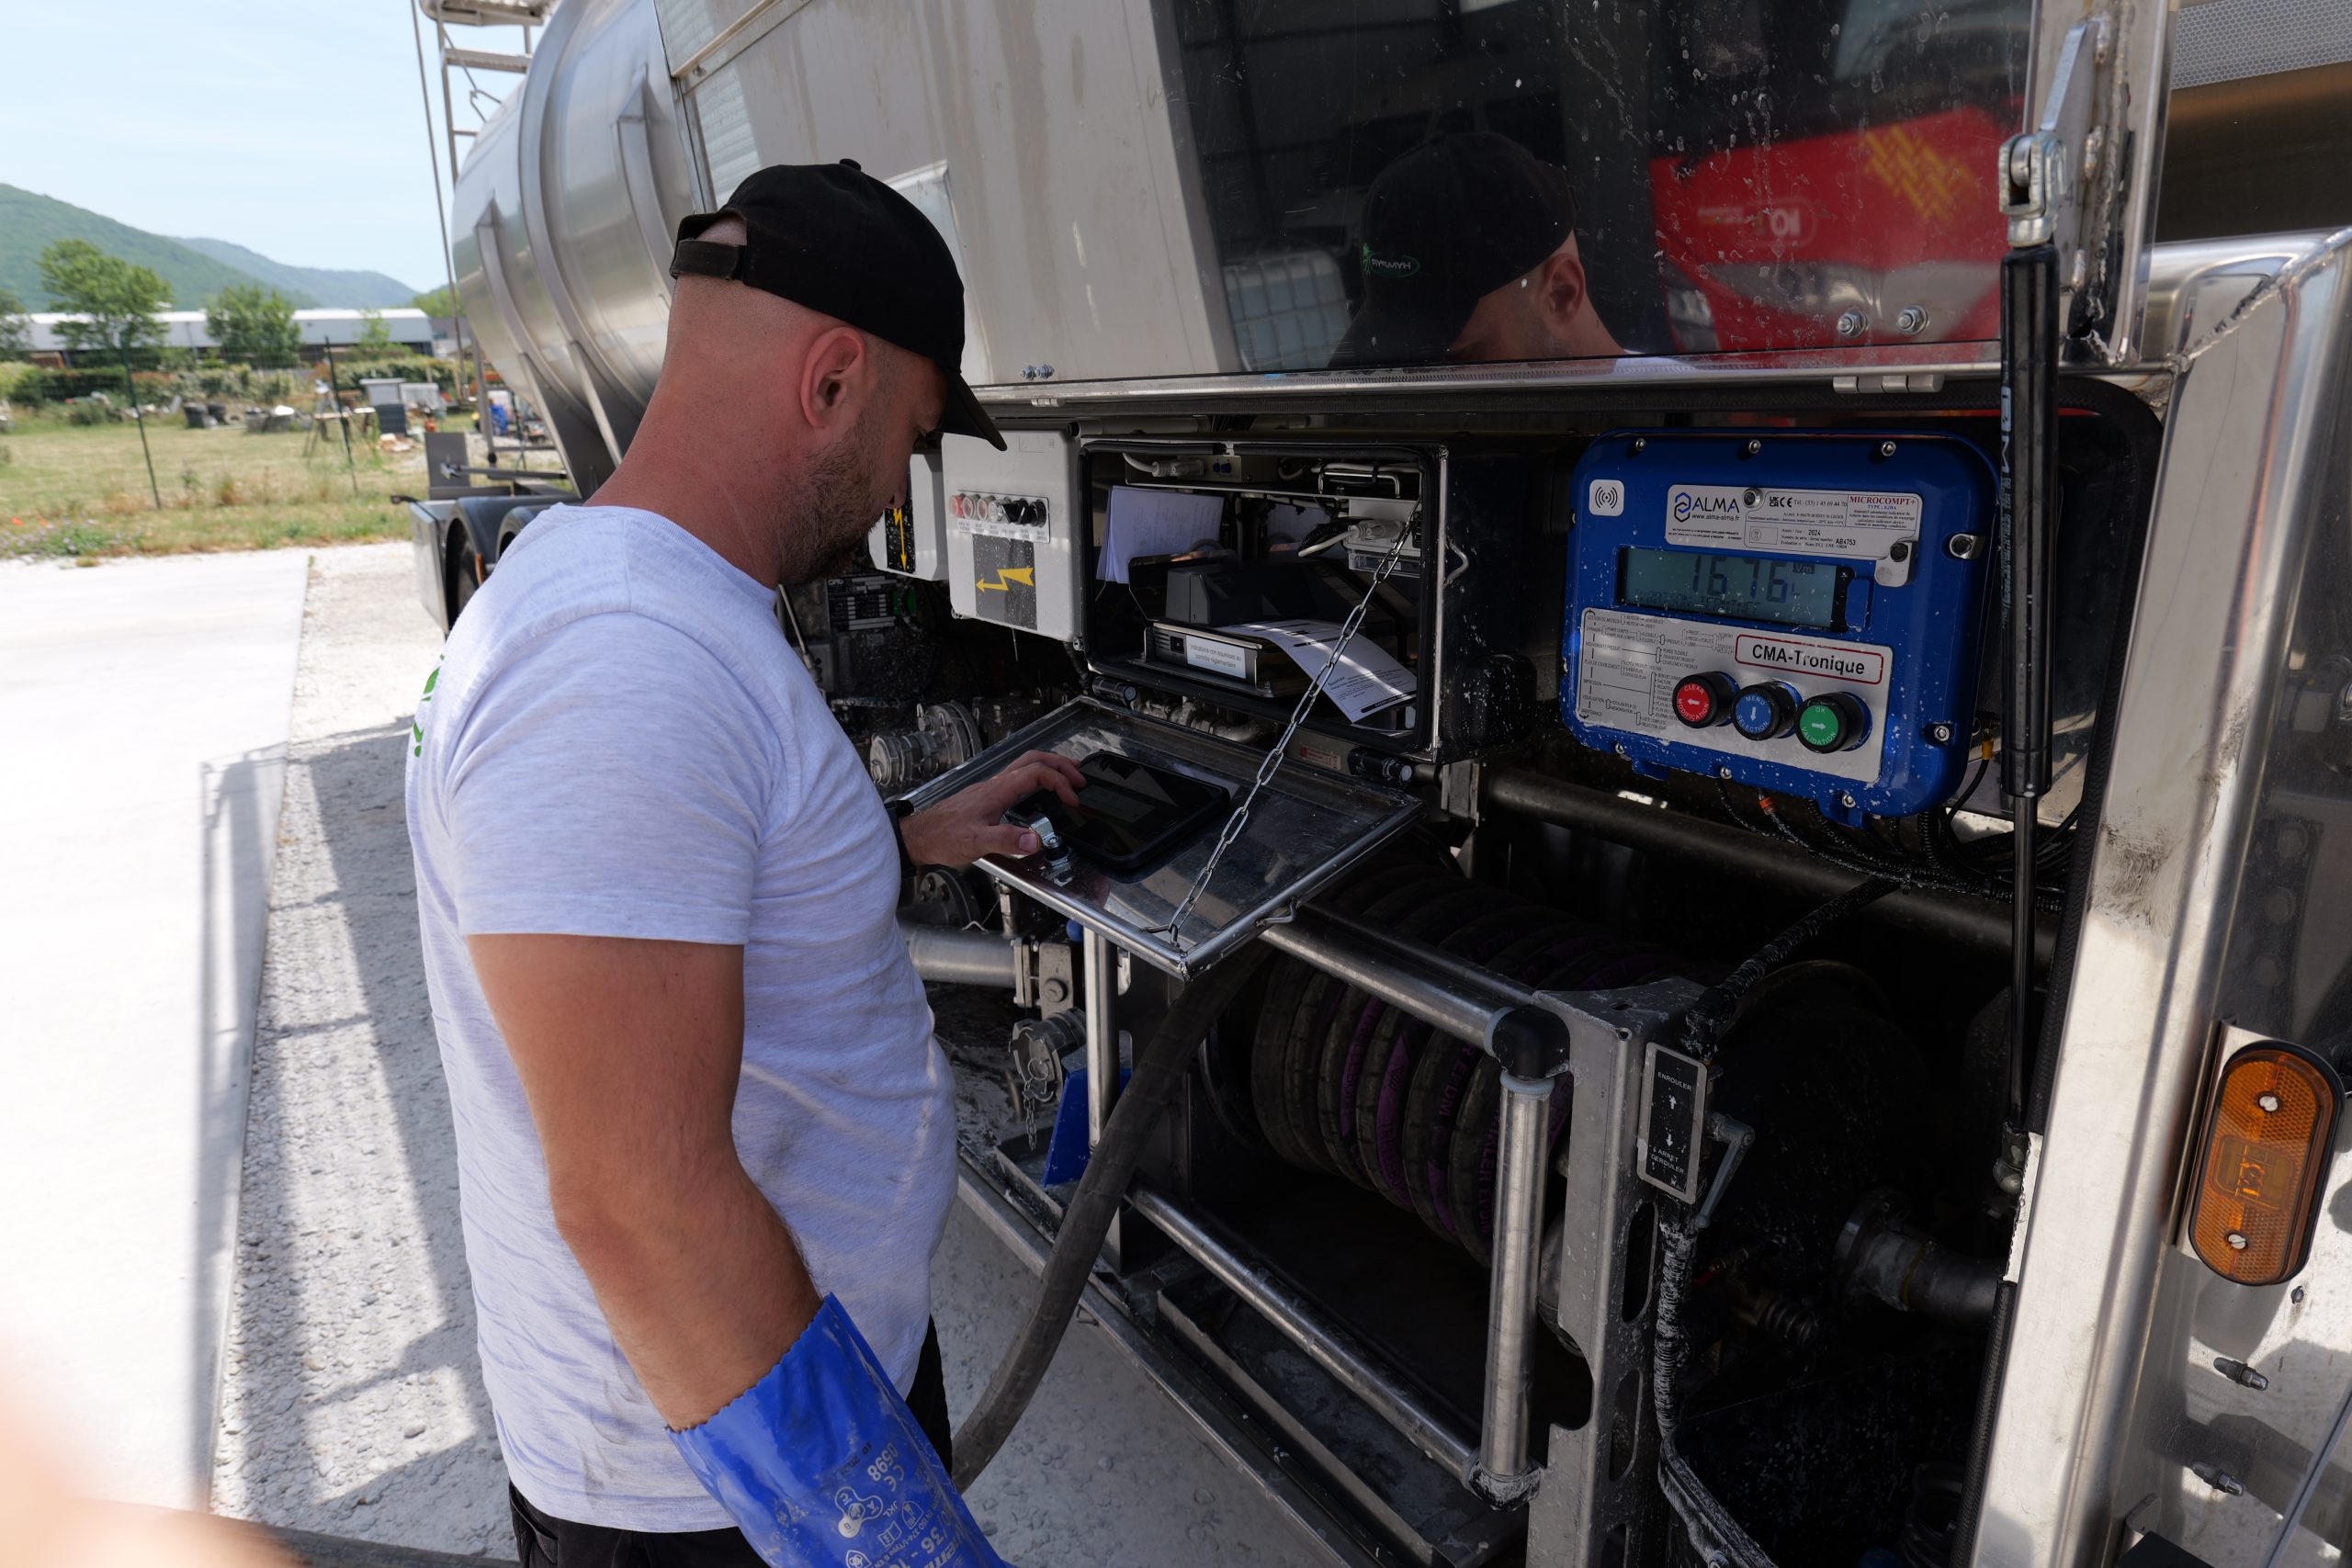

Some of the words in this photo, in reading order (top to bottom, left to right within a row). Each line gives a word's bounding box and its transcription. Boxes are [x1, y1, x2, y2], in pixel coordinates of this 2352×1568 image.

[1691, 496, 1740, 513] ALMA
[1691, 513, 1740, 523] www.alma-alma.fr
[1692, 553, 1790, 604] 1676
[1752, 644, 1865, 677] CMA-Tronique
[1683, 683, 1704, 695] CLEAR
[1745, 694, 1767, 706] MENU
[1677, 699, 1710, 722] MODIFICATION
[1736, 715, 1770, 734] SELECTION
[1801, 727, 1838, 747] VALIDATION
[1657, 1071, 1692, 1091] ENROULER
[1651, 1154, 1685, 1175] DEROULER
[866, 1442, 899, 1482] 0598
[883, 1501, 899, 1518] JKL
